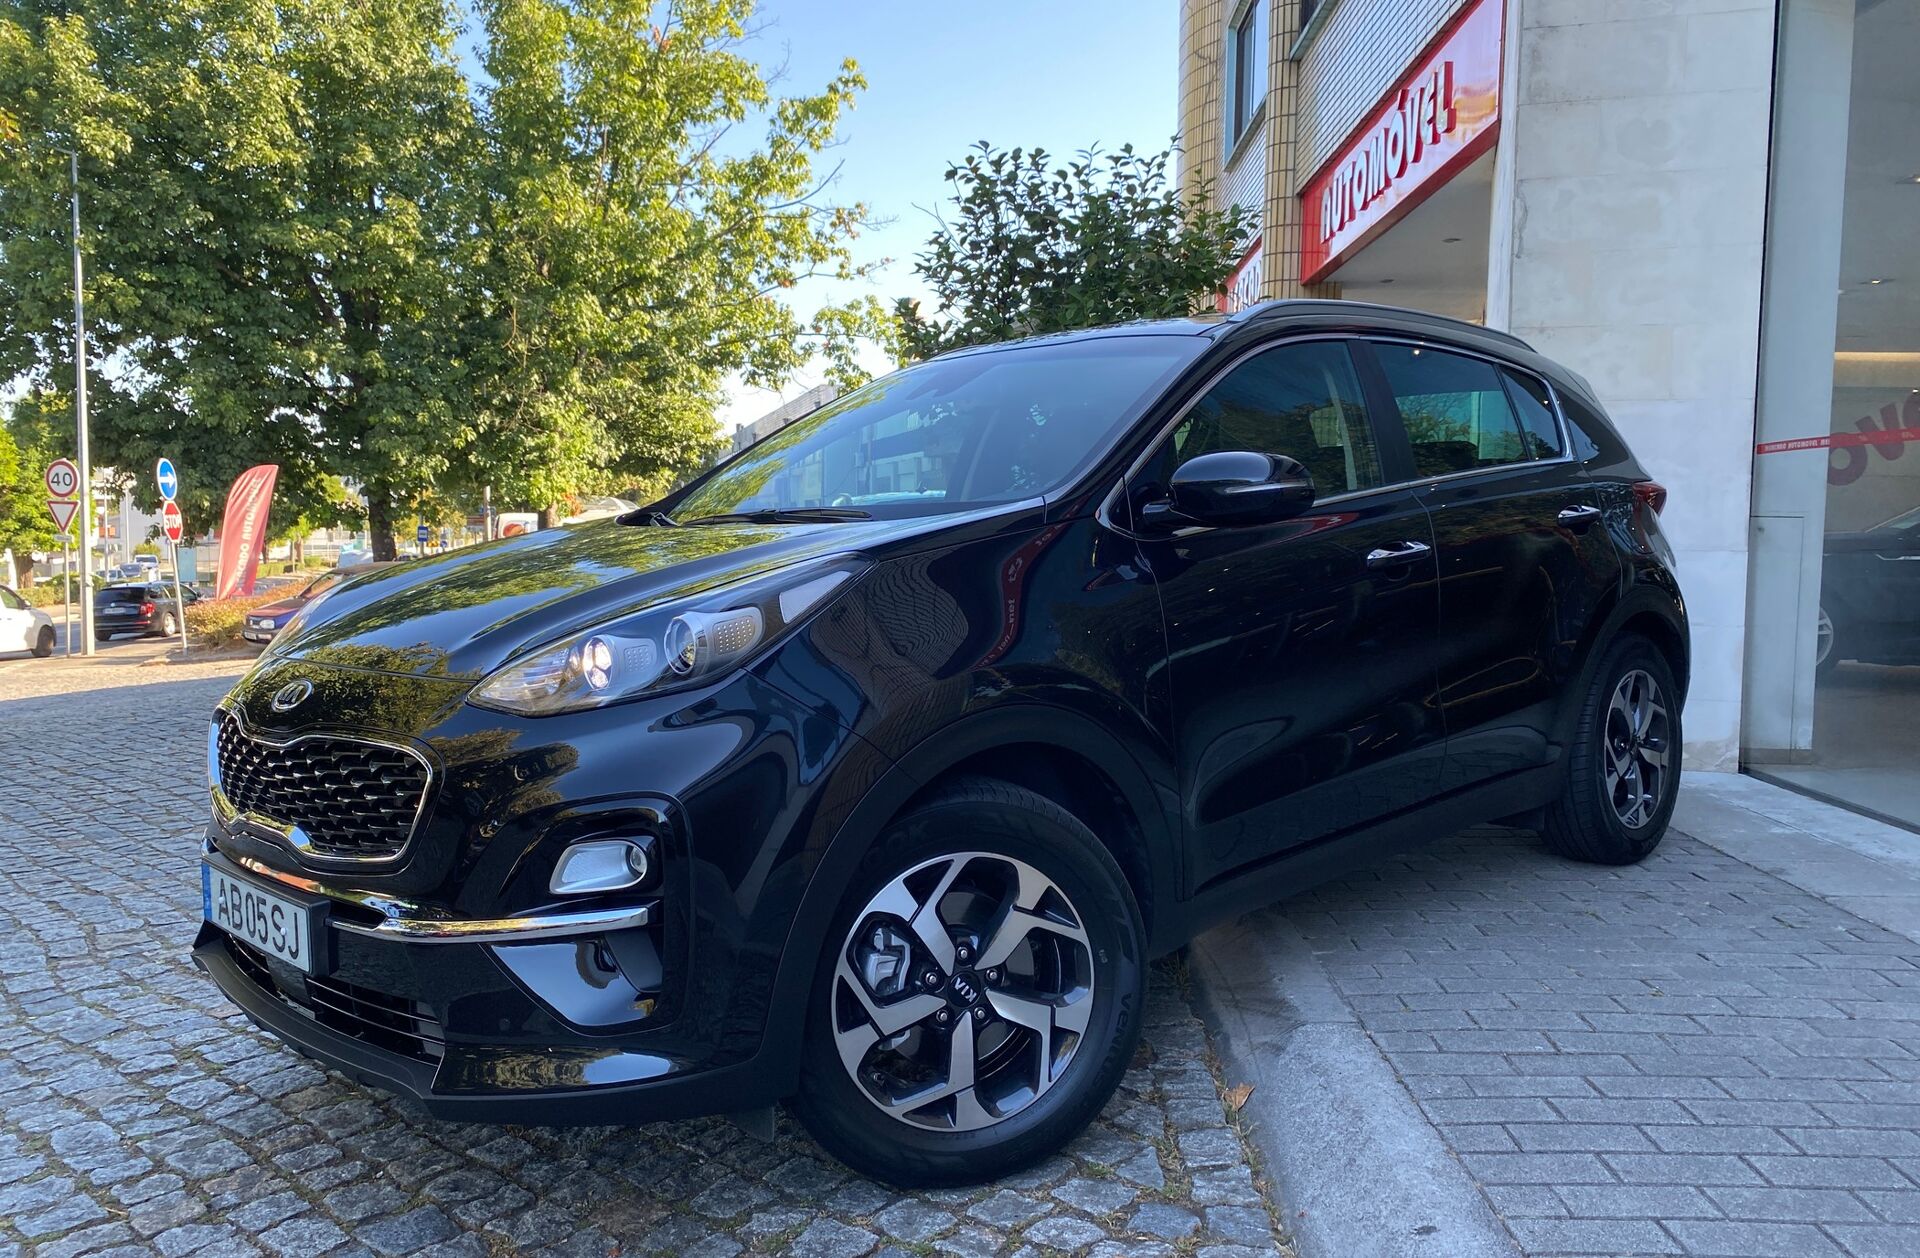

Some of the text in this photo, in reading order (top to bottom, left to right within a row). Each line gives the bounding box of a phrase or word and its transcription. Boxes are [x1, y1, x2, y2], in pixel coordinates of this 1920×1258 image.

[1320, 61, 1456, 244] AUTOMÓVEL
[51, 472, 72, 487] 40
[164, 514, 181, 529] STOP
[954, 977, 977, 1003] KIA
